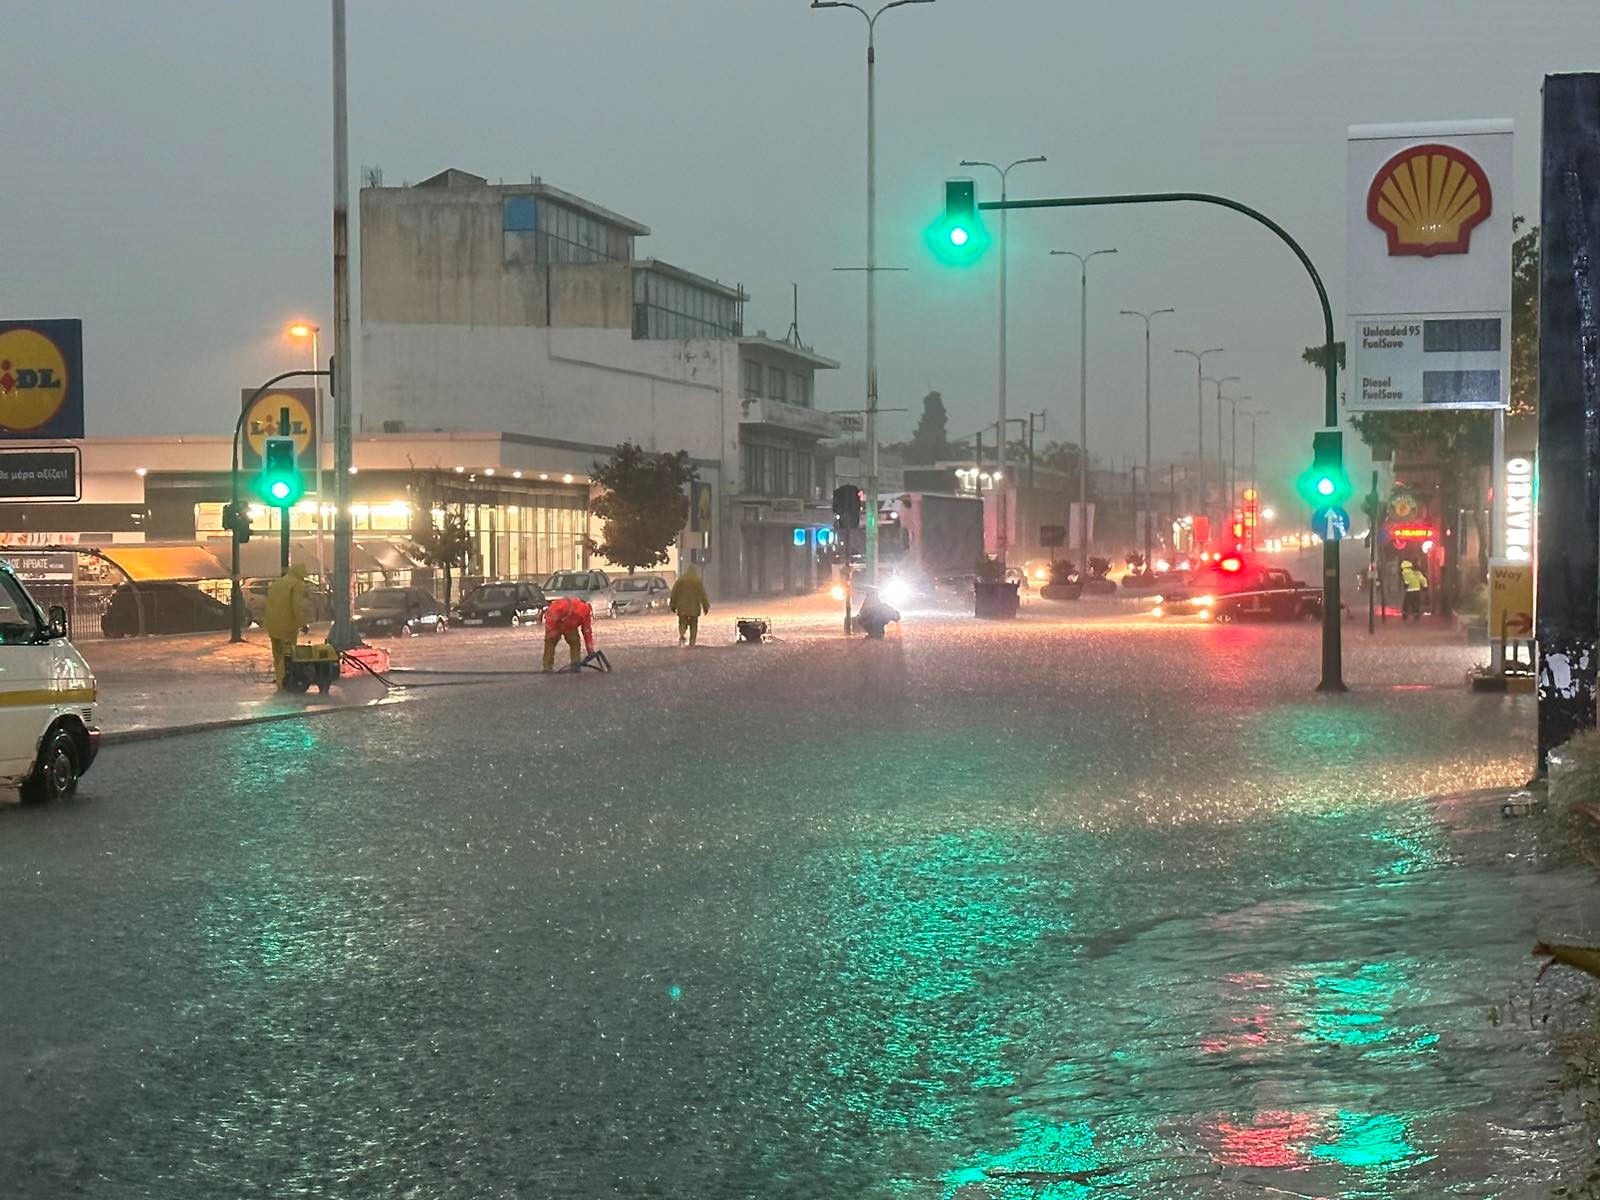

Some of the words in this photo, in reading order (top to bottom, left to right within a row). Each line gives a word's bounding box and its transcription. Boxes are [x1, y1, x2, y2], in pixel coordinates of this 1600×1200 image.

[1363, 325, 1408, 337] Unleaded
[1408, 325, 1421, 336] 95
[1363, 338, 1403, 349] FuelSave
[1362, 376, 1391, 388] Diesel
[1362, 389, 1403, 400] FuelSave
[11, 469, 35, 481] μέρα
[1494, 568, 1521, 581] Way
